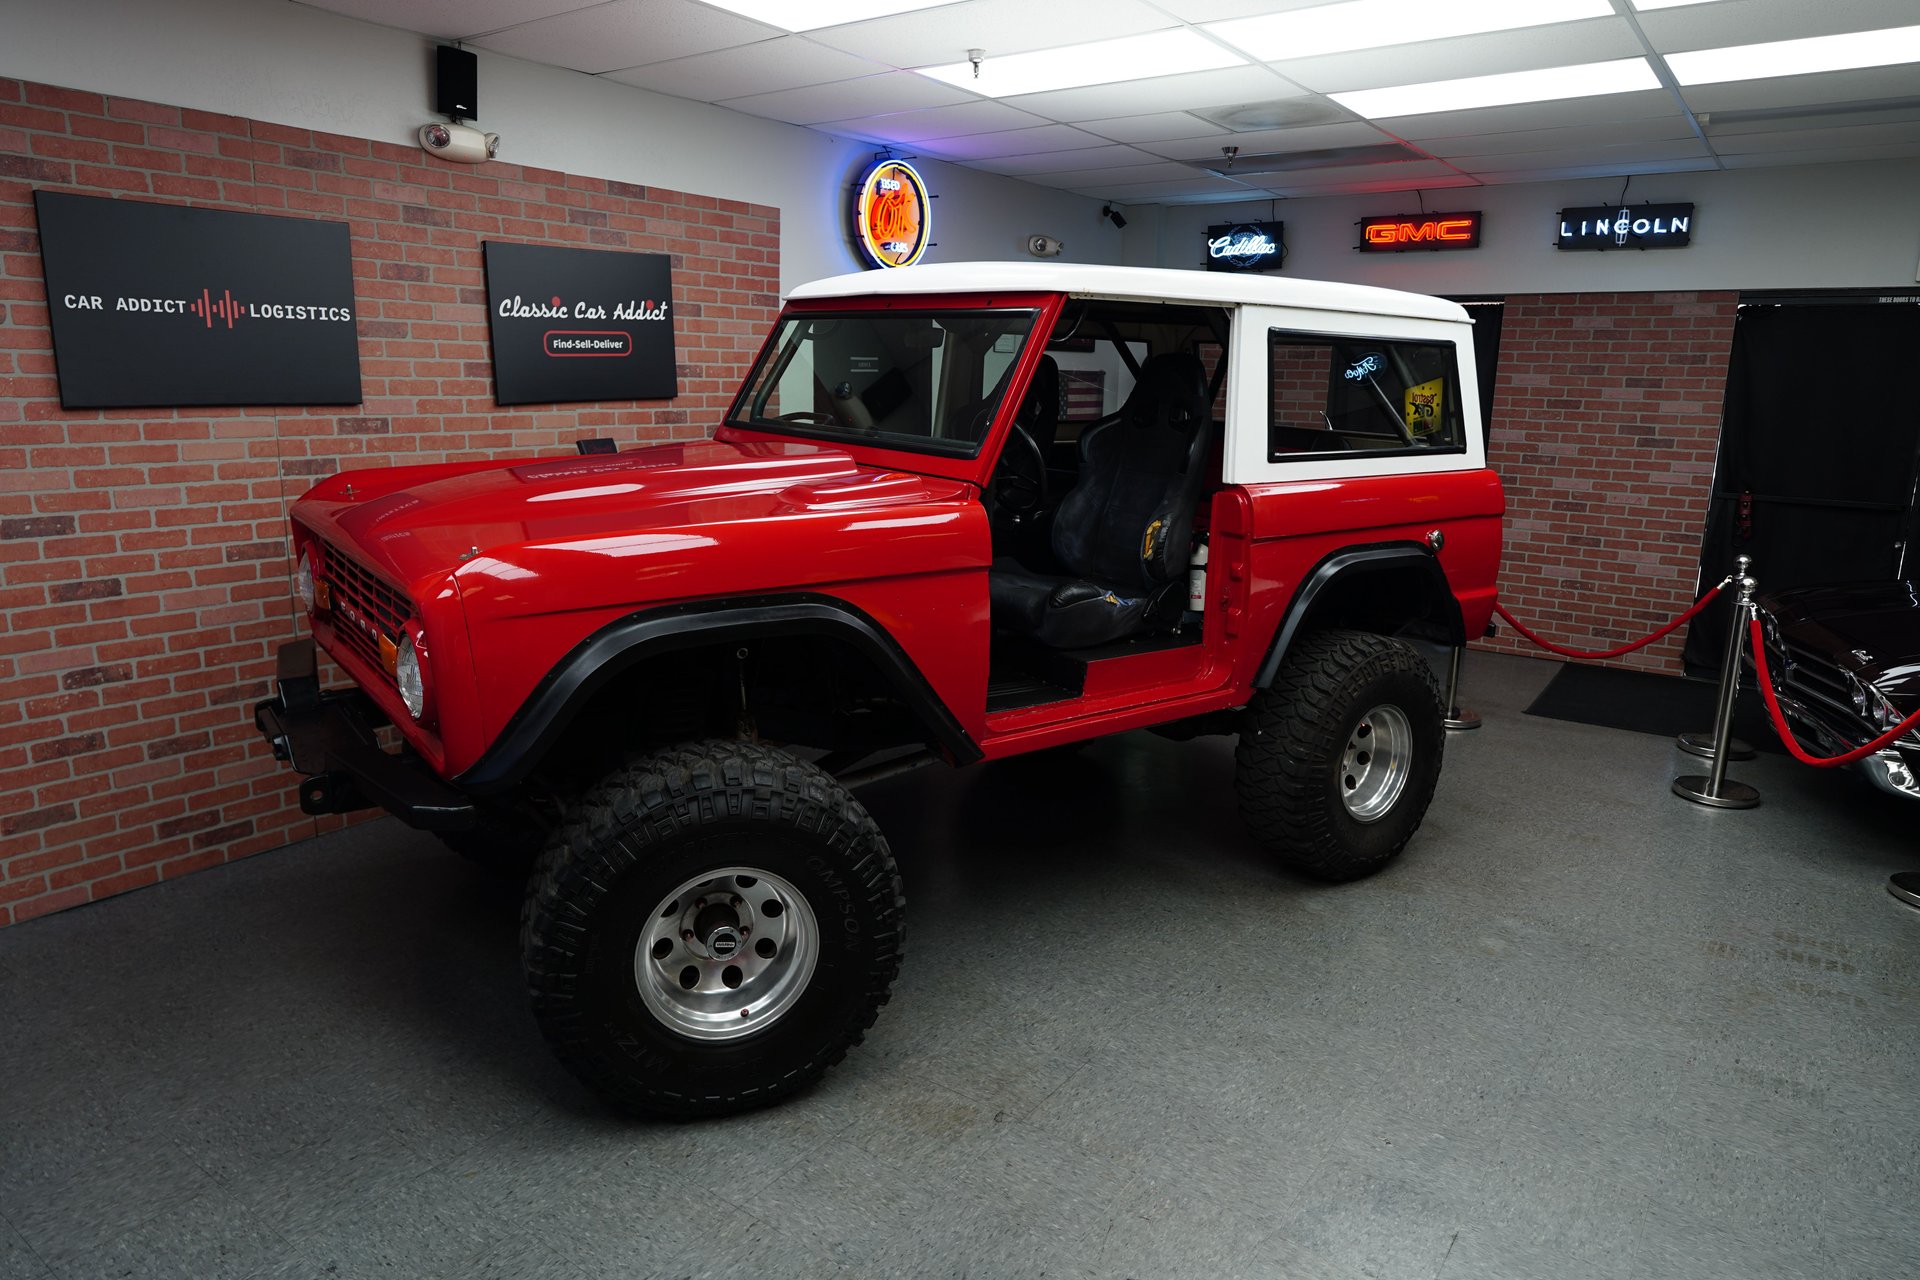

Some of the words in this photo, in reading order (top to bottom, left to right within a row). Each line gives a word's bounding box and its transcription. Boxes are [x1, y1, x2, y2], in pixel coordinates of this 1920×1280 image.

[1365, 219, 1473, 244] GMC
[1560, 216, 1689, 238] LINCOLN
[1208, 235, 1276, 258] Cadillac
[64, 294, 104, 311] CAR
[116, 297, 187, 314] ADDICT
[250, 303, 351, 322] LOGISTICS
[499, 295, 569, 318] Classic
[574, 301, 607, 319] Car
[612, 300, 669, 321] Addict
[553, 339, 624, 350] Find-Sell-Deliver
[340, 601, 378, 641] FORD
